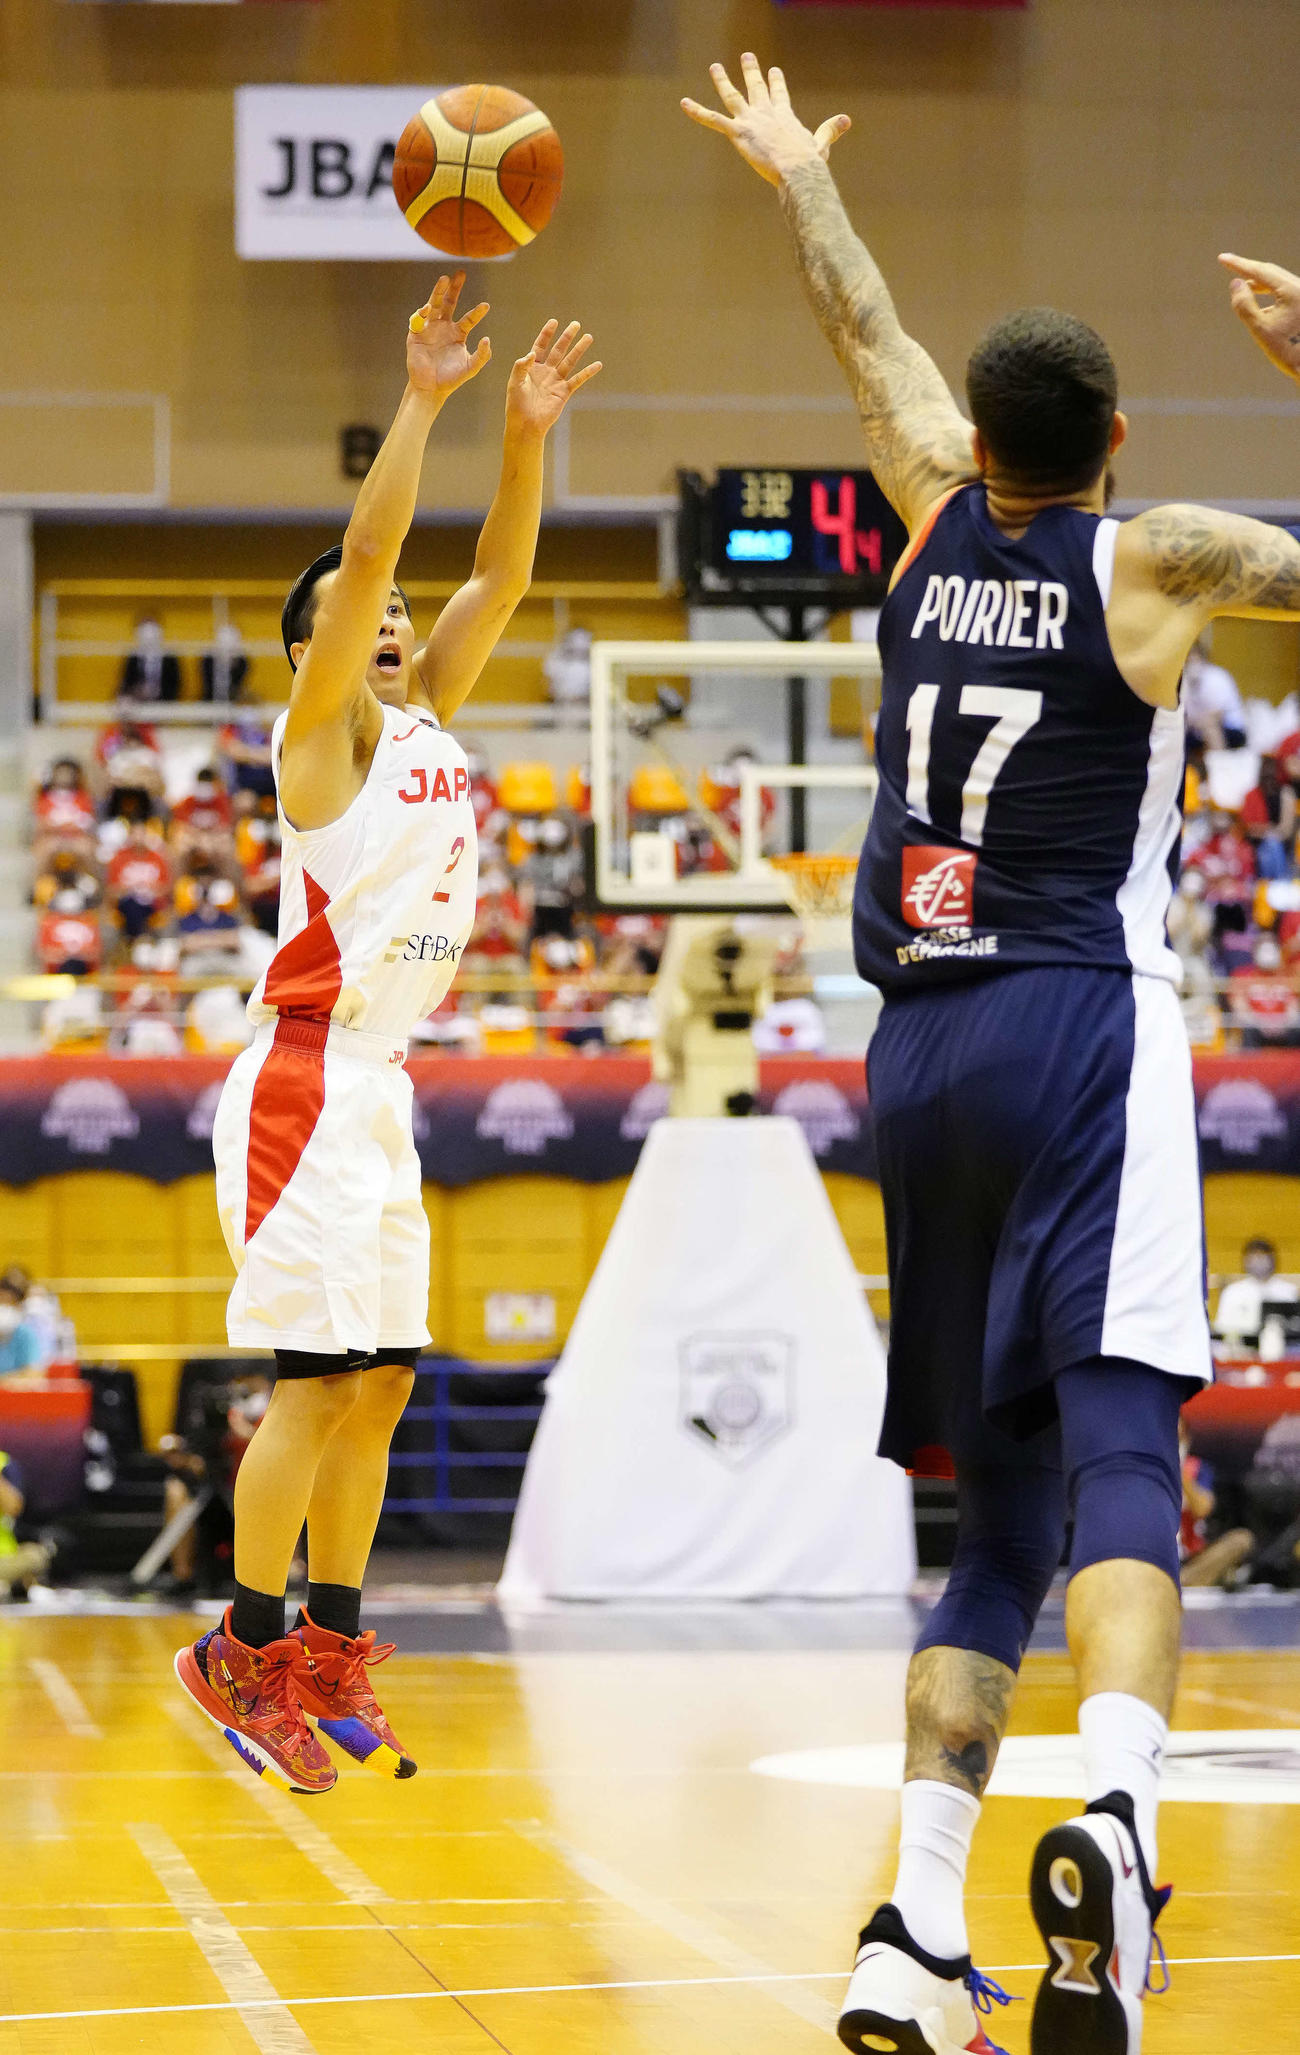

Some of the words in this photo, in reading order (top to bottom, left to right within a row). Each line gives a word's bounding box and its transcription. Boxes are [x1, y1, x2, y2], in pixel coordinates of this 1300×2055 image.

[911, 575, 1069, 650] POIRIER
[398, 767, 472, 804] JAP
[905, 683, 1044, 847] 17
